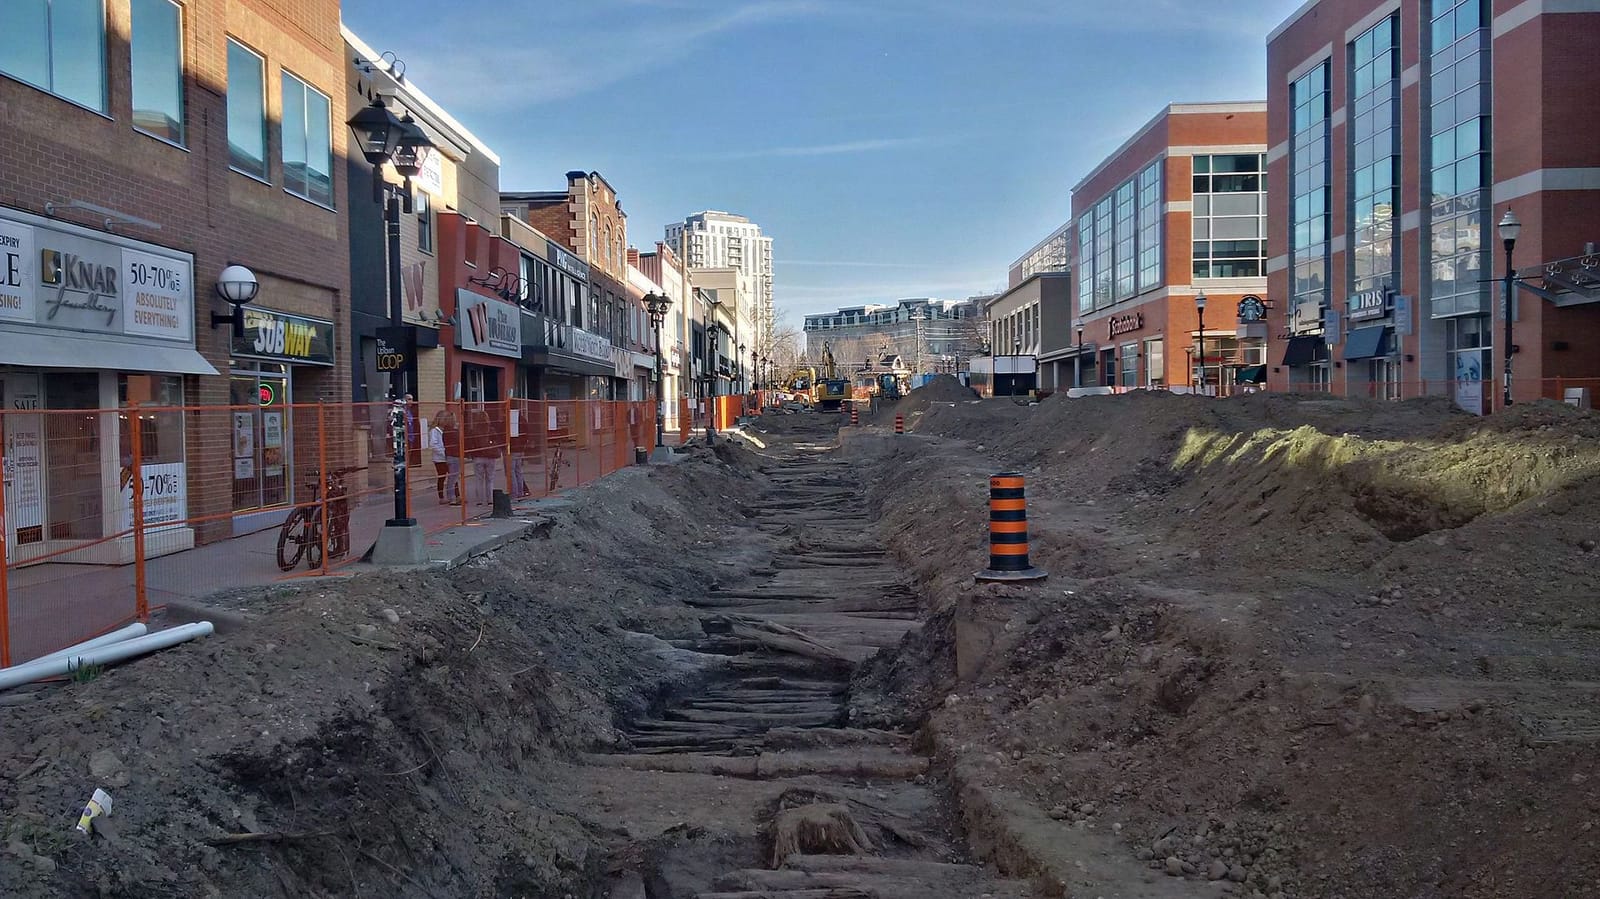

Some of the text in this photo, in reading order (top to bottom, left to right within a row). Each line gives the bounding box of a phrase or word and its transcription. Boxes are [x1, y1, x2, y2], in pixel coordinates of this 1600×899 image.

[64, 253, 117, 294] KNAR
[131, 263, 175, 291] 50-70%
[46, 287, 117, 327] Jewellery
[136, 292, 177, 311] ABSOLUTELY
[1360, 290, 1382, 309] IRIS
[134, 310, 179, 329] EVERYTHING!
[254, 316, 316, 358] SUBWAY
[377, 354, 404, 370] LOOP
[129, 474, 172, 500] 5-70%
